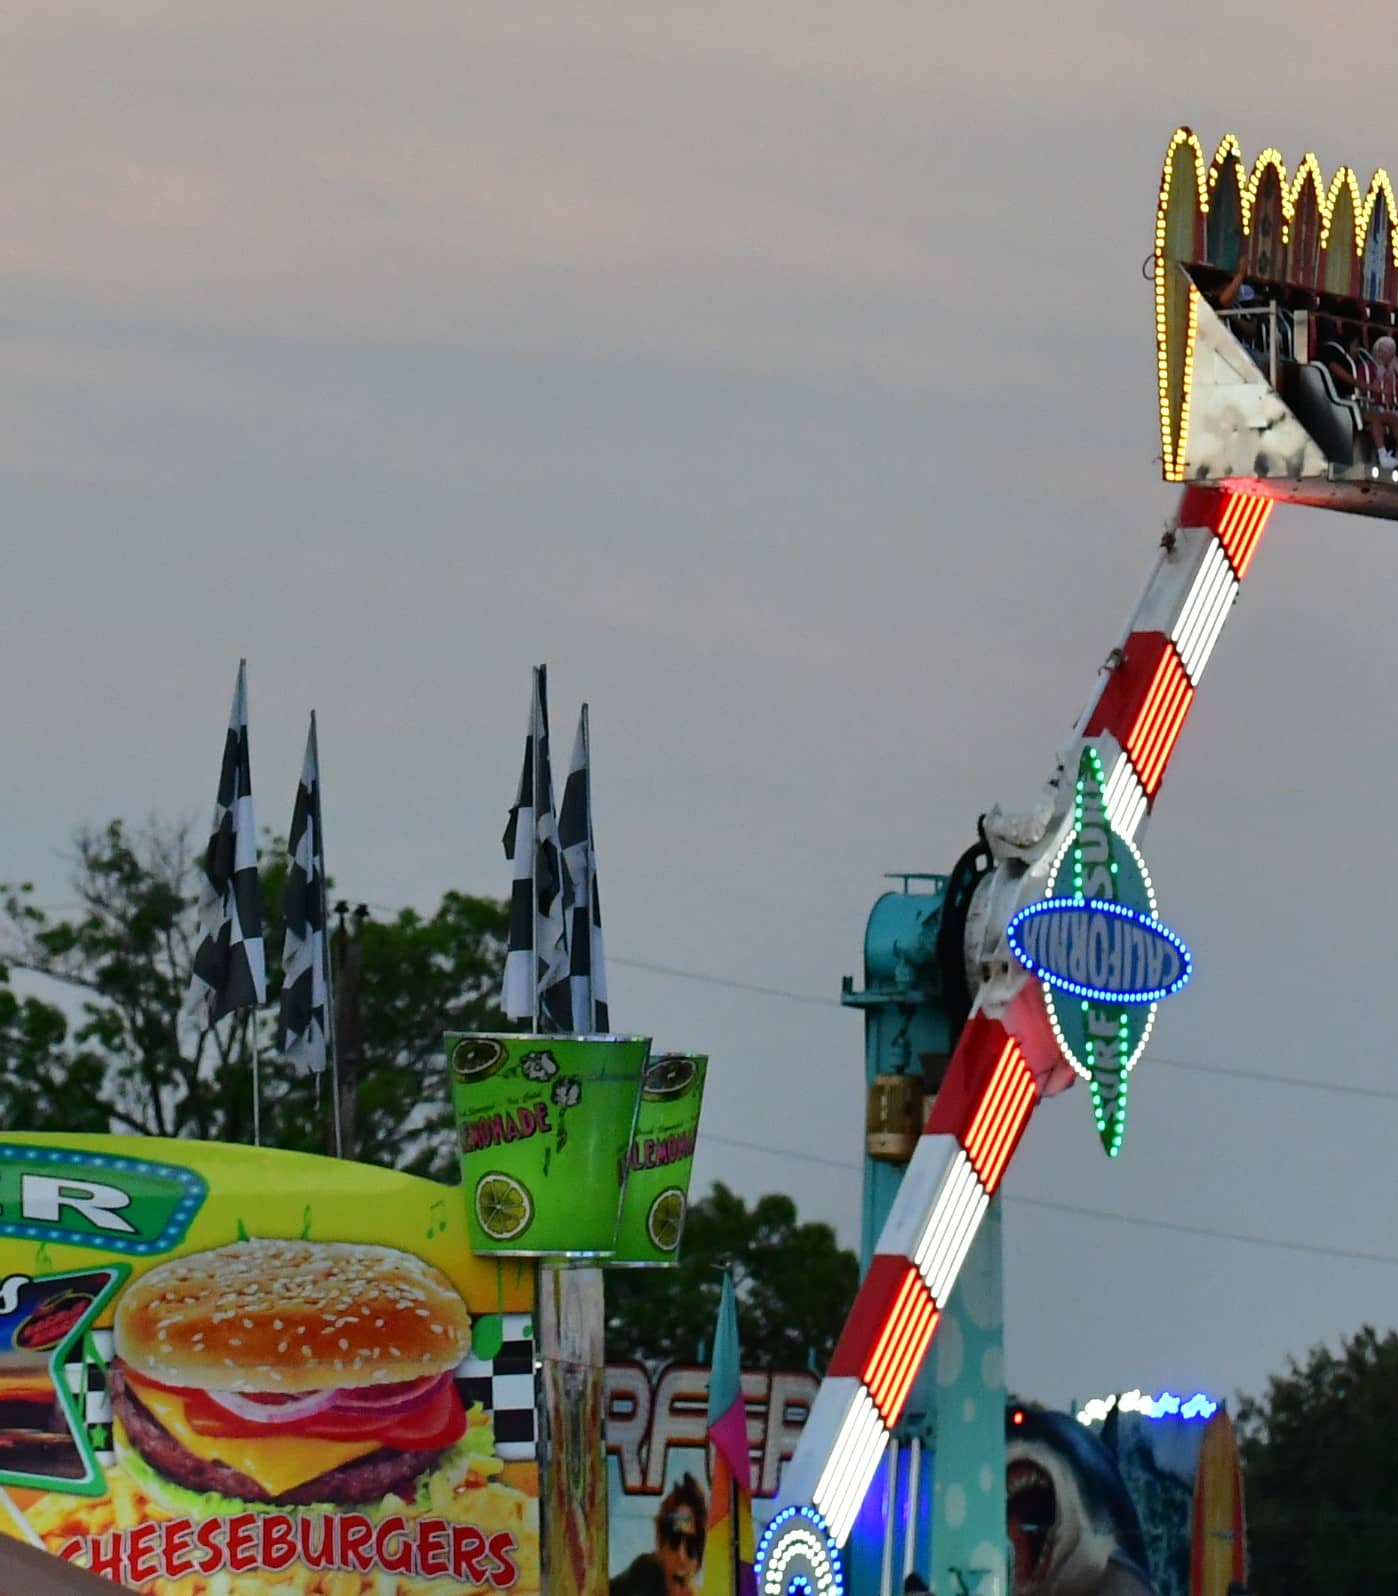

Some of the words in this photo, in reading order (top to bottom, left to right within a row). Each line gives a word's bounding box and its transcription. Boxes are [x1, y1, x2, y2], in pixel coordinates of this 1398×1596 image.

[1021, 912, 1181, 991] CALIFORNIA
[1088, 1007, 1121, 1120] SURF
[462, 1101, 552, 1153] EMONADE
